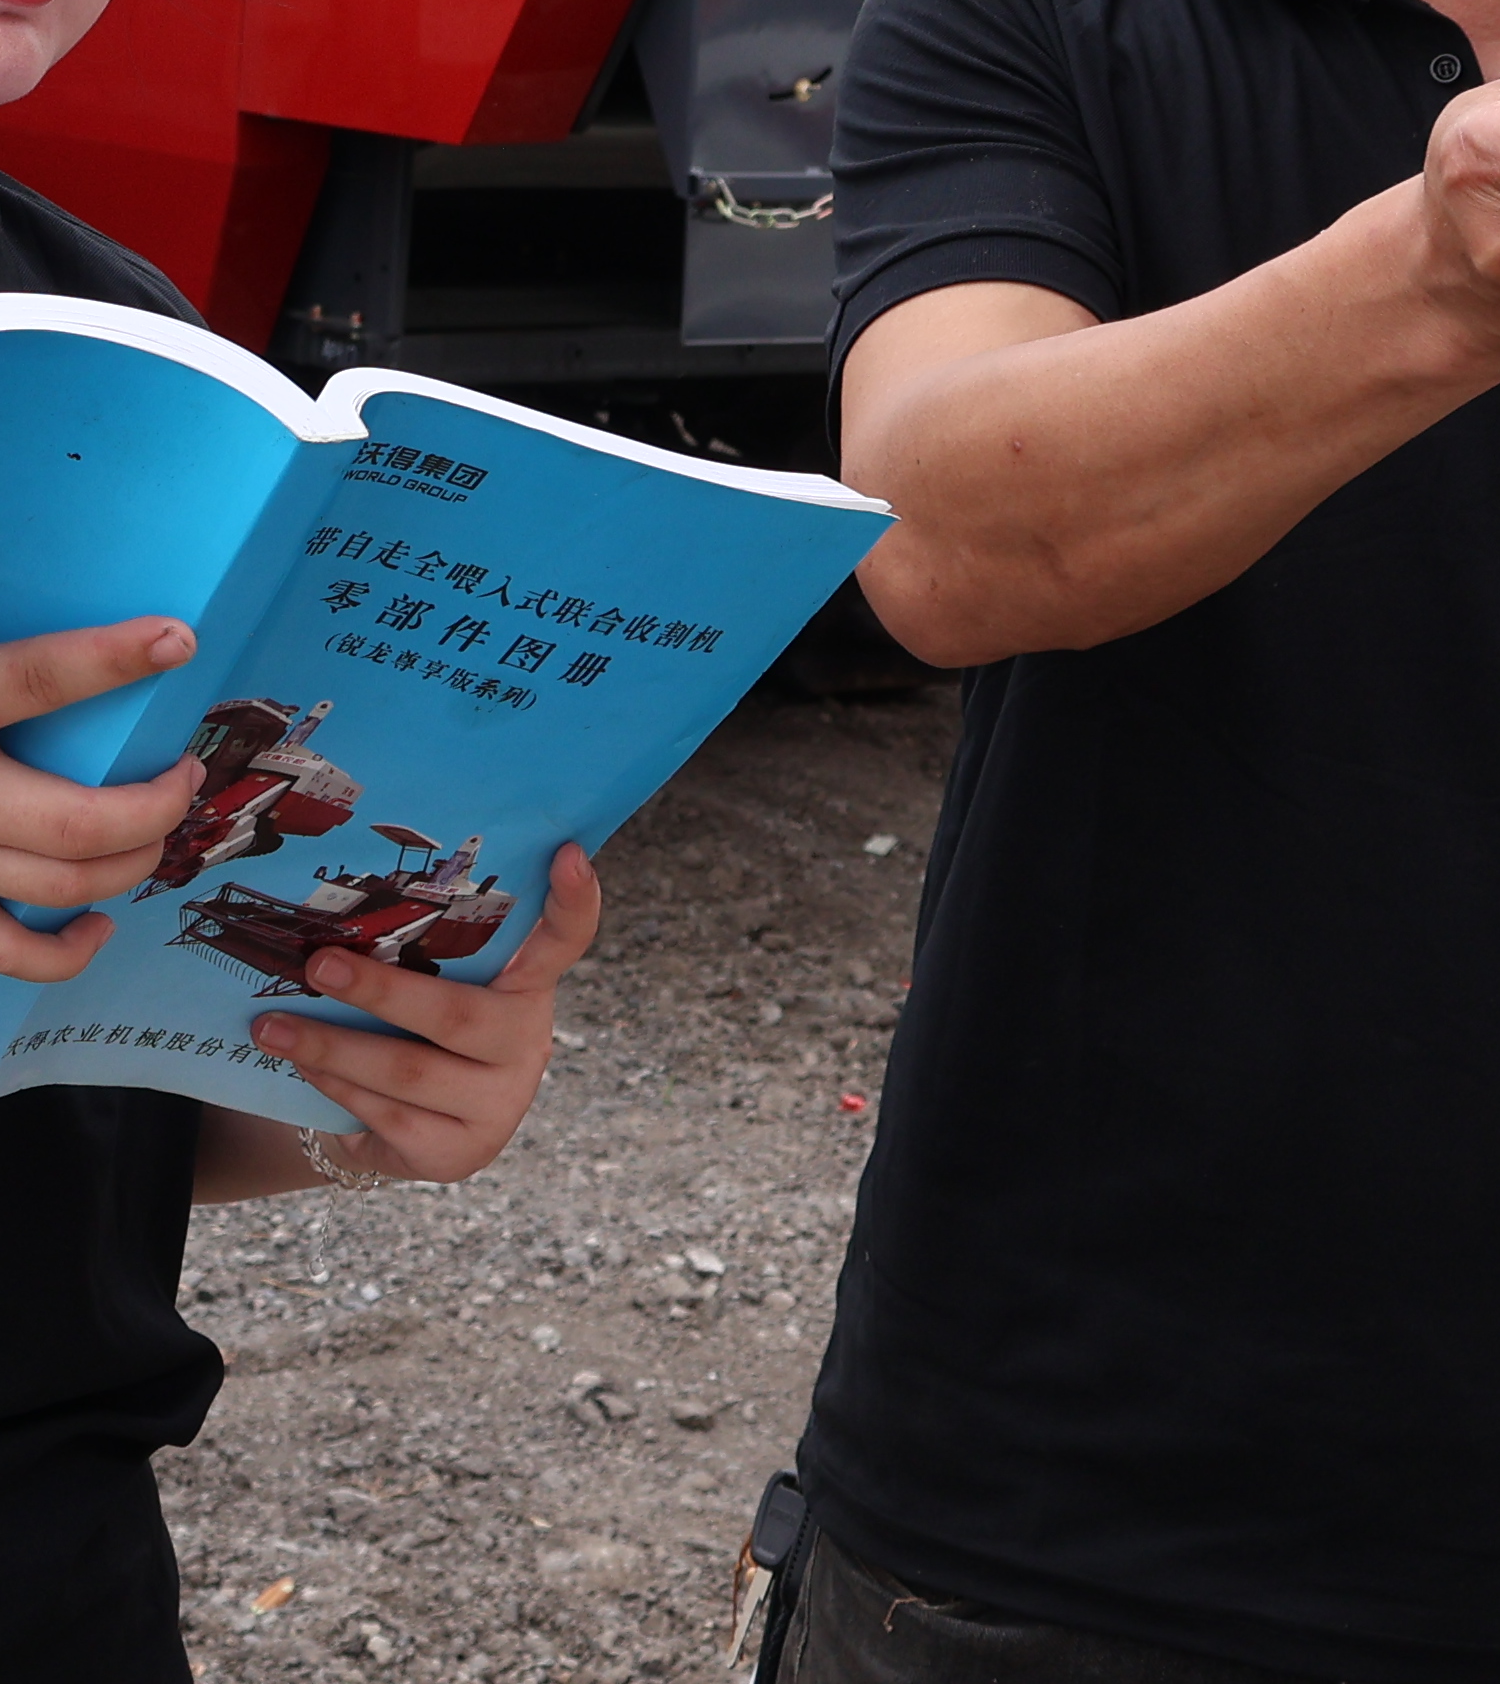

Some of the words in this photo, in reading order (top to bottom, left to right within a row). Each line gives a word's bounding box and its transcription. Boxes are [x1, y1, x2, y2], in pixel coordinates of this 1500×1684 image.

[342, 469, 402, 486] WORLD
[402, 478, 470, 504] GROUP
[351, 441, 489, 491] 沃得集团
[304, 525, 726, 655] 带自走全喂入式联合收割机
[319, 579, 614, 687] 零部件图册
